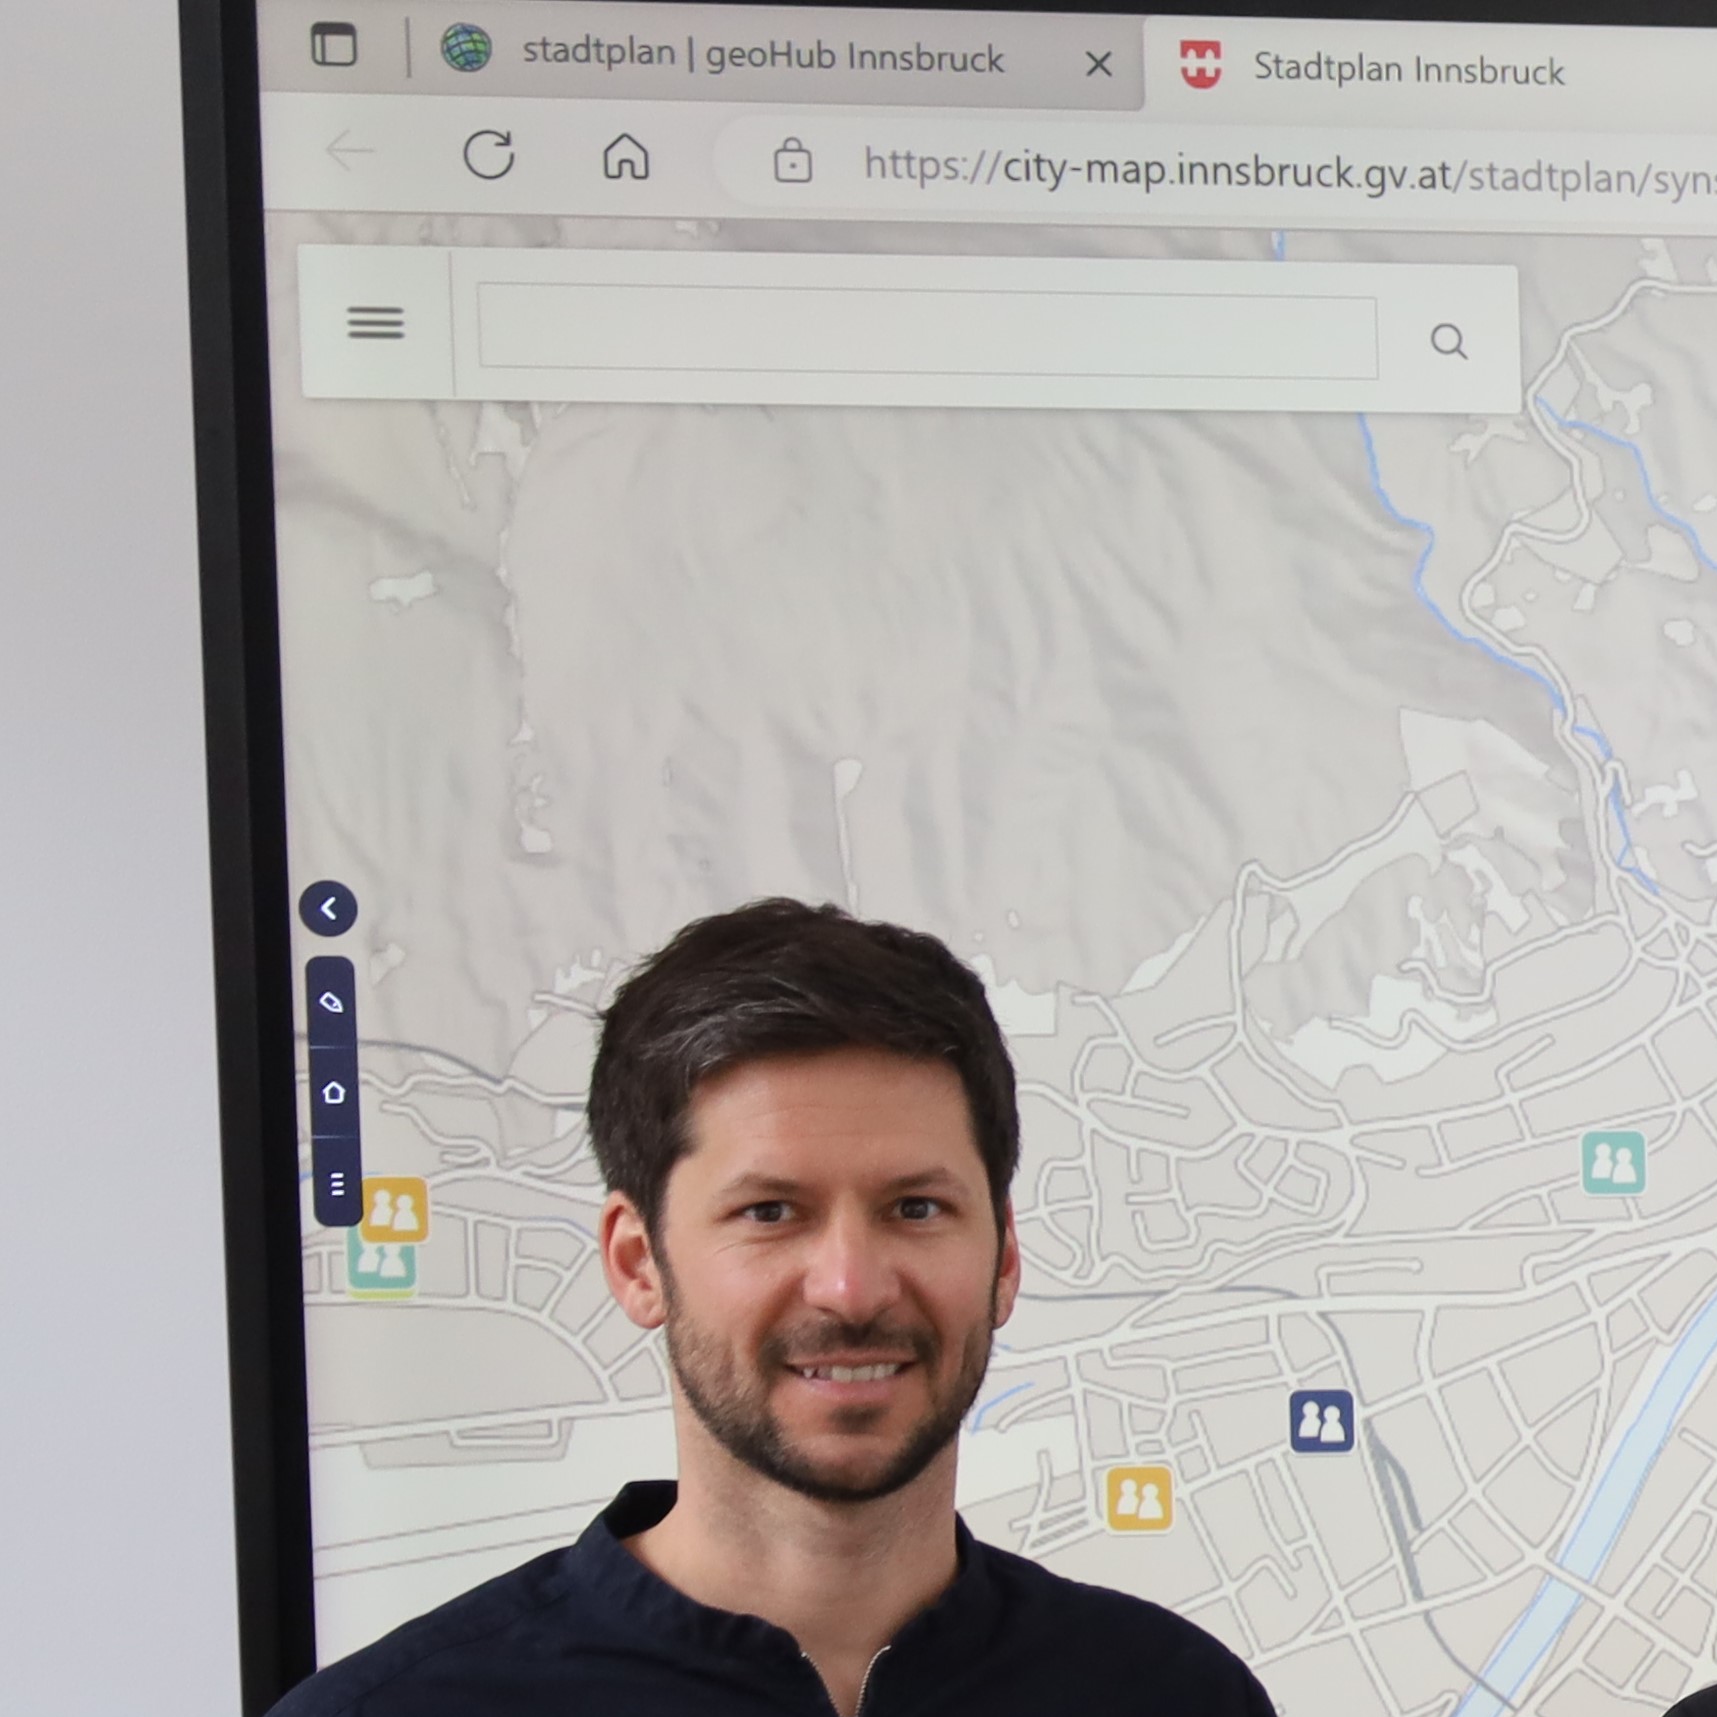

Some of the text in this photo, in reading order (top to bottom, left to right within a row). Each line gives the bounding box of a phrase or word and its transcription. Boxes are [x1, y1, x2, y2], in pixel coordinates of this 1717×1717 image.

[523, 35, 676, 71] stadtplan
[706, 40, 836, 74] geoHub
[848, 42, 1006, 74] Innsbruck
[1255, 51, 1566, 88] Stadtplan Innsbruck
